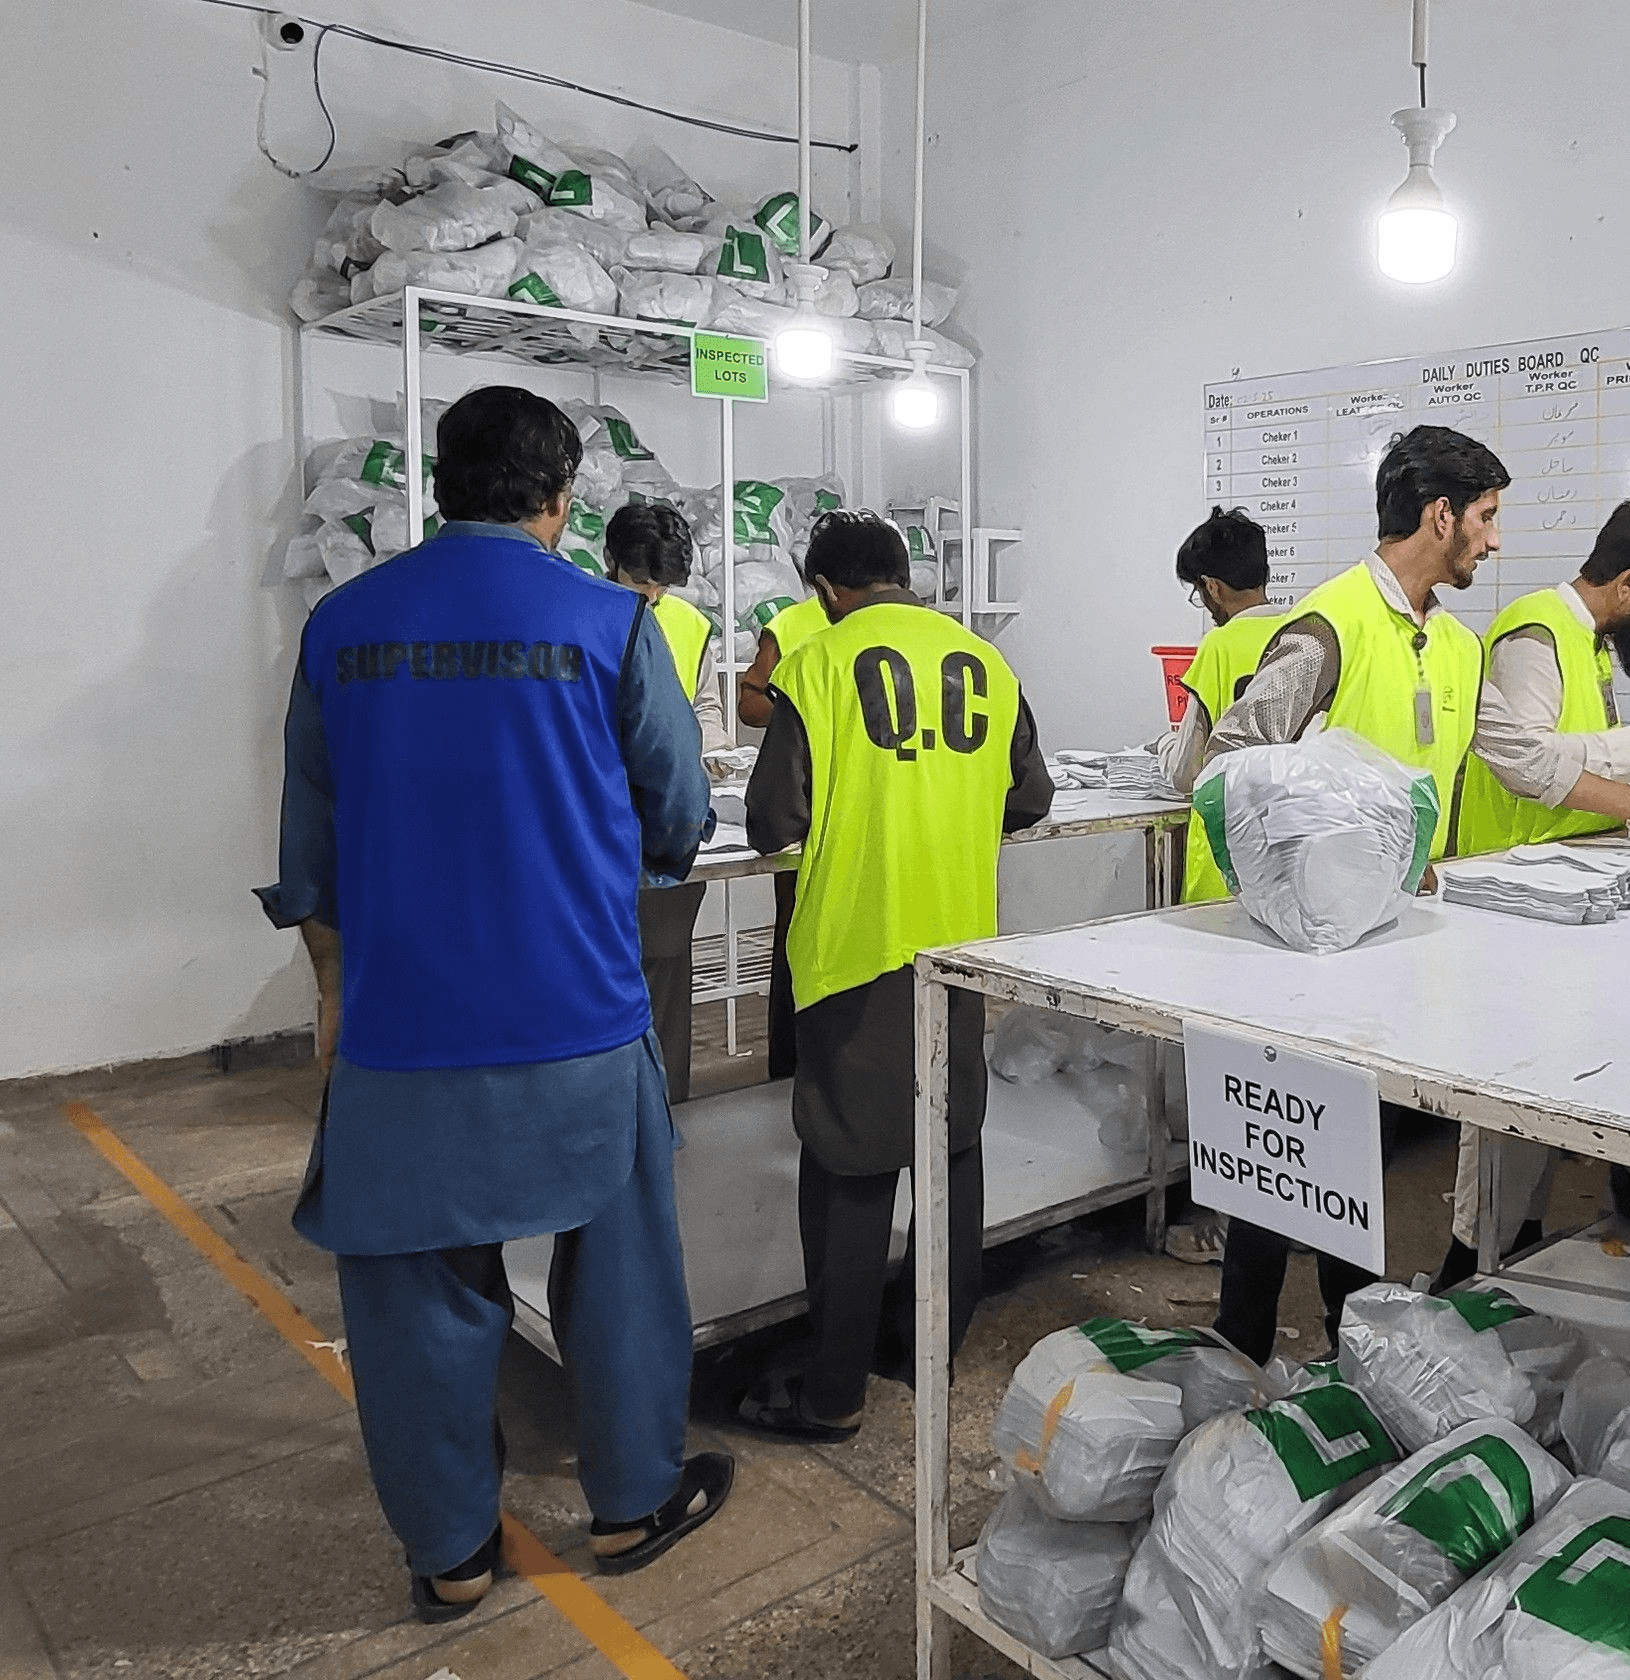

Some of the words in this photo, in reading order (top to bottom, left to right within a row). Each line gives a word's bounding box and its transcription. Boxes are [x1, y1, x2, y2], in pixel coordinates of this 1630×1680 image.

[696, 347, 764, 366] INSPECTED
[1422, 365, 1456, 383] DAILY
[1466, 358, 1510, 378] DUTIES
[1518, 351, 1564, 372] BOARD
[1580, 346, 1600, 364] QC
[714, 370, 747, 384] LOTS
[1528, 370, 1574, 381] Worker
[1433, 382, 1475, 394] Worker
[1557, 380, 1577, 391] QC
[1208, 394, 1233, 409] Date:
[1428, 394, 1461, 406] AUTO
[1463, 392, 1482, 401] QC
[1246, 405, 1309, 420] OPERATIONS
[1217, 436, 1222, 447] 1
[1262, 432, 1291, 443] Cheker
[1216, 459, 1222, 470] 2
[1261, 454, 1290, 465] Cheker
[1292, 453, 1298, 463] 2
[1216, 480, 1222, 491] 3
[1261, 477, 1291, 488] Cheker
[1293, 476, 1298, 487] 3
[1260, 501, 1290, 512] Cheker
[1291, 500, 1296, 509] 4
[1290, 572, 1296, 582] 7
[854, 645, 990, 762] Q.C
[1224, 1074, 1326, 1131] READY
[1245, 1120, 1307, 1168] FOR
[1192, 1140, 1369, 1230] INSPECTION
